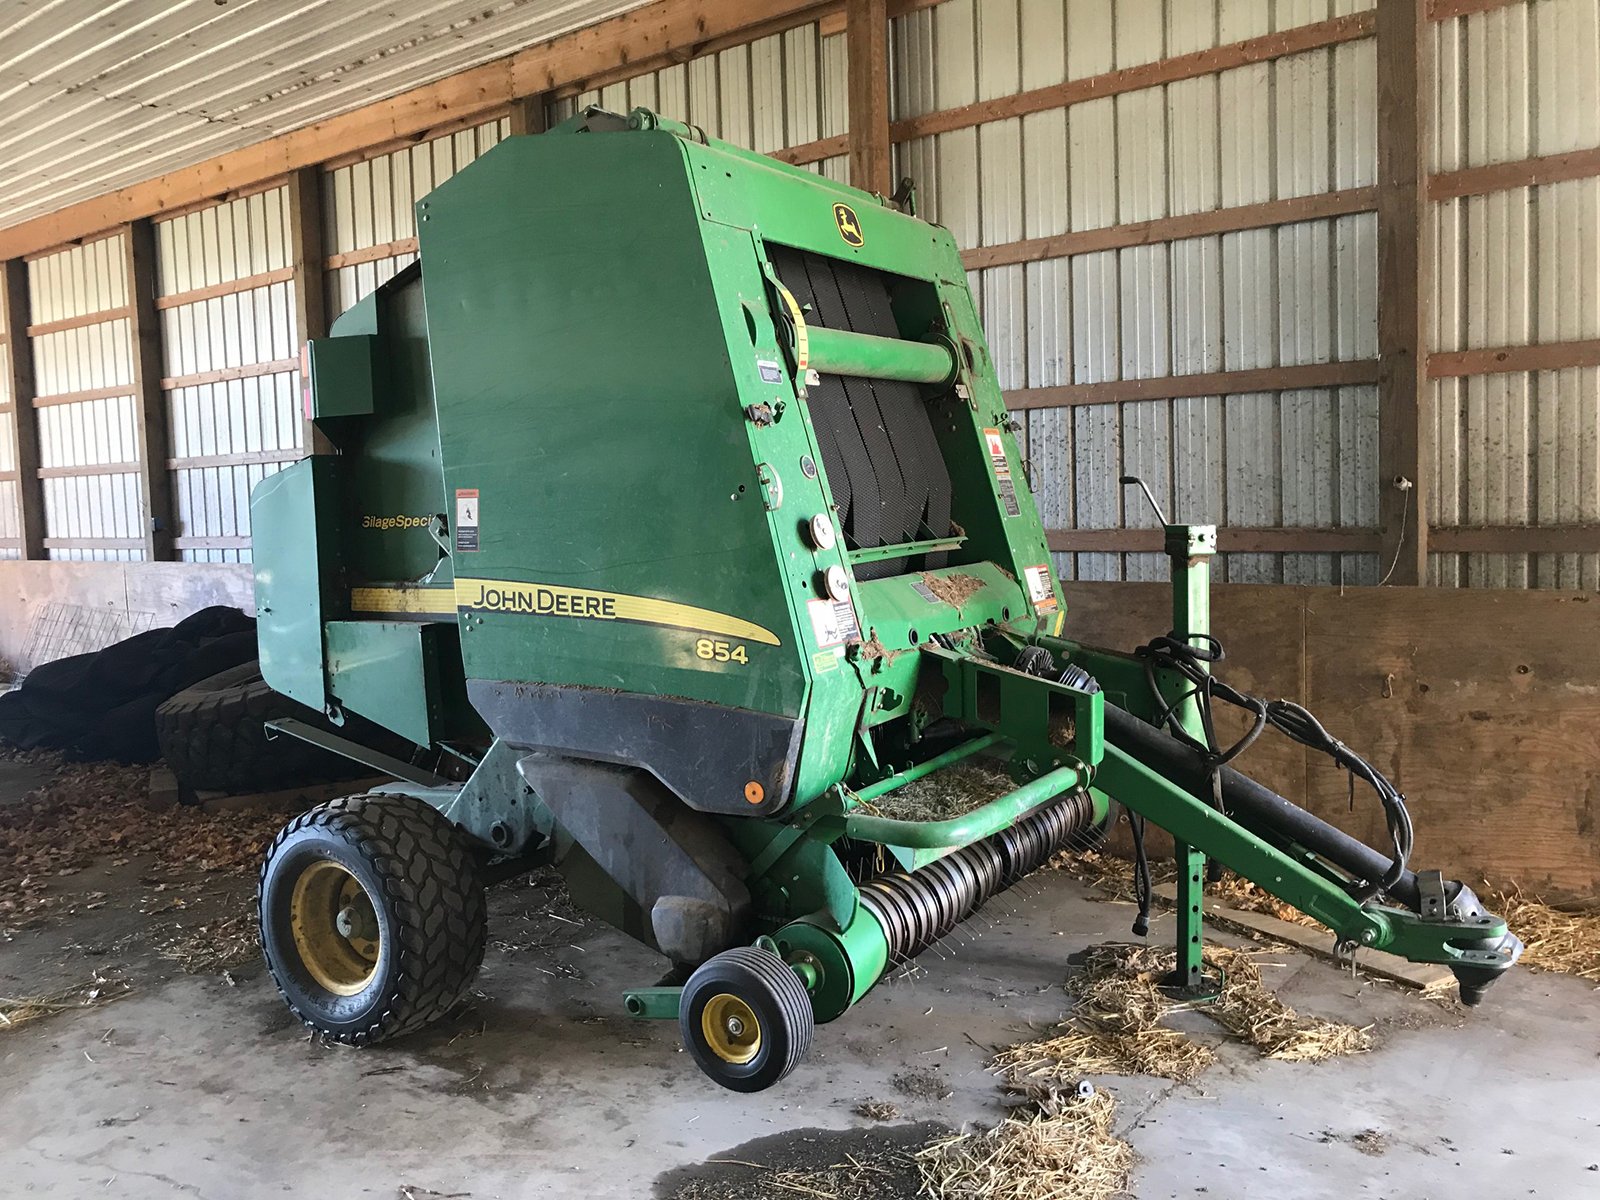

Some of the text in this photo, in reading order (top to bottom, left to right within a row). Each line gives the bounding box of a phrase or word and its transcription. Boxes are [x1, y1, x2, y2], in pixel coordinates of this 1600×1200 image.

[362, 513, 434, 530] SilageSpeci
[474, 585, 616, 616] JOHN DEERE
[696, 638, 749, 665] 854
